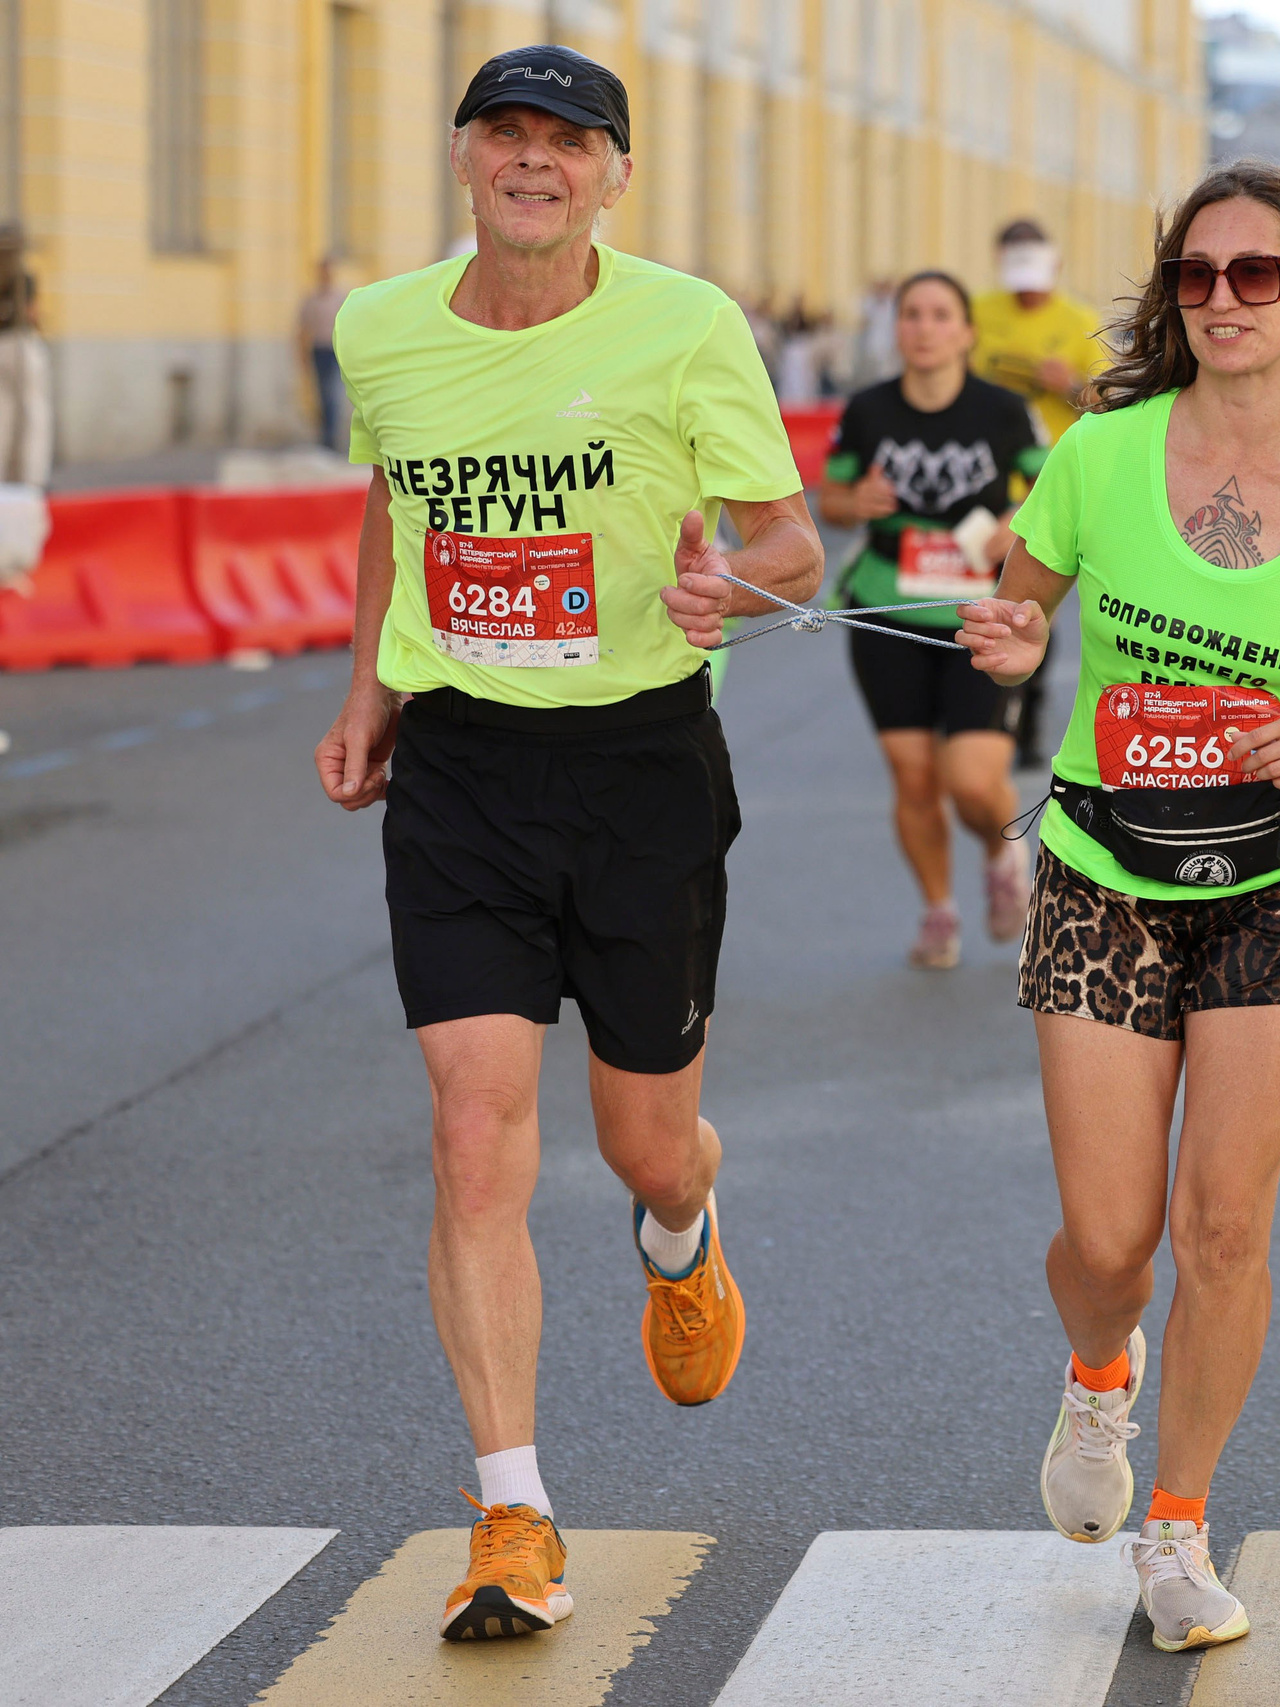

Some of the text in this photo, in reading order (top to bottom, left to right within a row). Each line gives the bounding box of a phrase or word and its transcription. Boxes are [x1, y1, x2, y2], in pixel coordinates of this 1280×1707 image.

[555, 410, 600, 419] DEMIX
[387, 440, 615, 497] НЕЗРЯЧИЙ
[425, 494, 567, 532] БЕГУН
[459, 549, 517, 559] ПЕТЕРБУРГСКИЙ
[459, 556, 493, 564] МАРАФОН
[529, 548, 579, 559] ПушкинРан
[448, 582, 536, 617] 6284
[569, 591, 585, 610] D
[450, 617, 536, 637] ВЯЧЕСЛАВ
[1116, 635, 1268, 688] НЕЗРЯЧЕГО
[1144, 691, 1161, 699] 97-Й
[1143, 699, 1208, 708] ПЕТЕРБУРГСКИЙ
[1143, 706, 1181, 714] МАРАФОН
[1220, 698, 1270, 708] ПушкинРан
[1125, 734, 1224, 769] 6256
[1121, 771, 1230, 789] АНАСТАСИЯ
